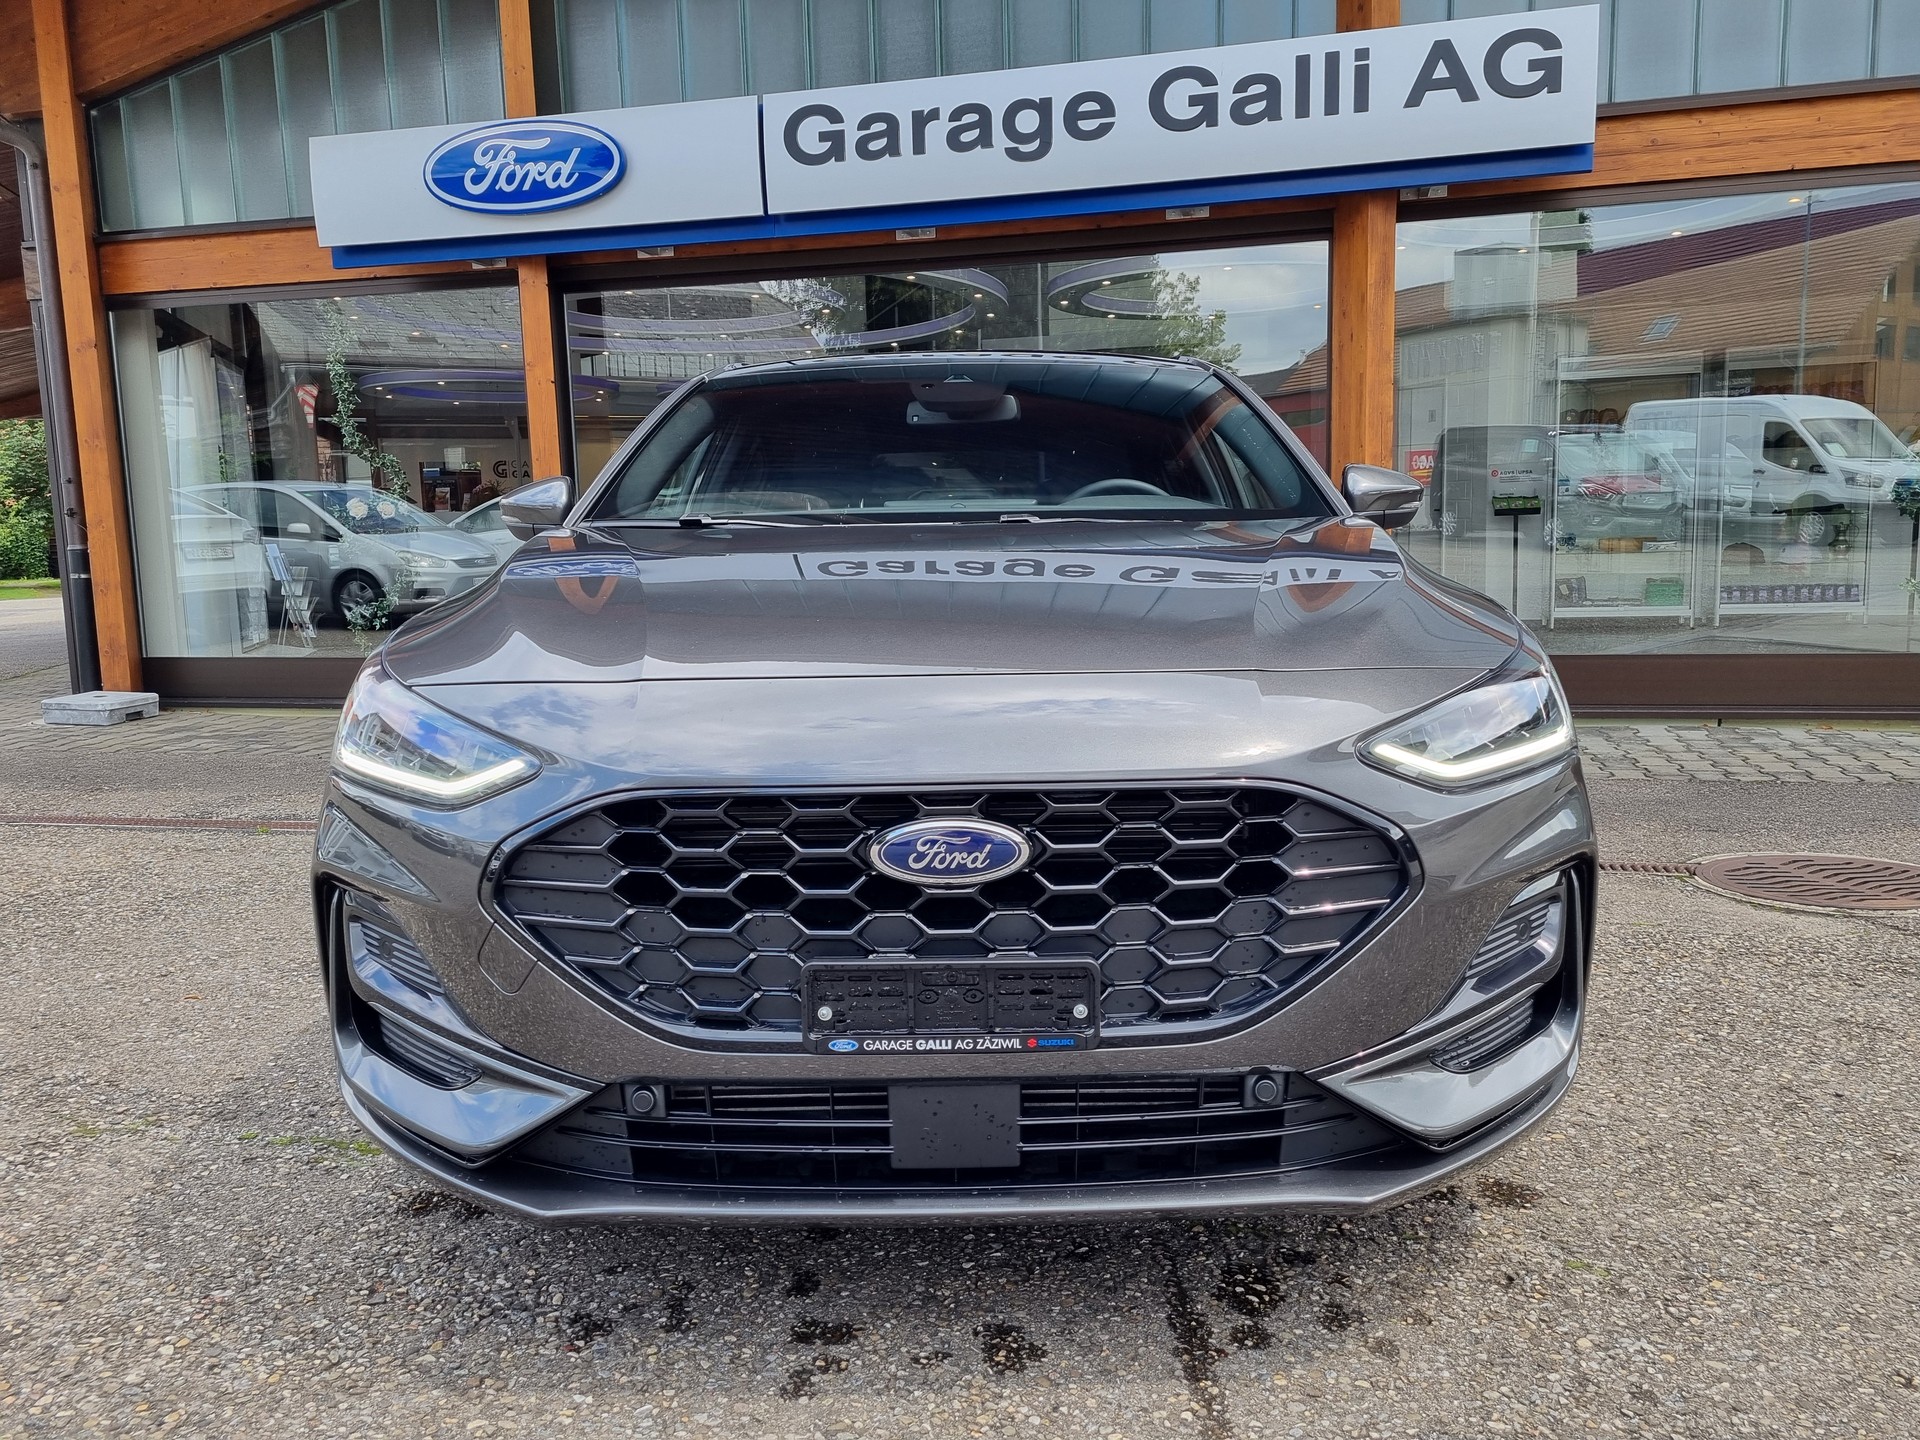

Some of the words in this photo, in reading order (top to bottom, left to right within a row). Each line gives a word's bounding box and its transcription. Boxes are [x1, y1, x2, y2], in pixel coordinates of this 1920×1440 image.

[783, 90, 1116, 166] Garage
[1148, 46, 1370, 132] Galli
[1403, 28, 1563, 108] AG
[464, 137, 581, 195] Ford
[511, 460, 530, 469] GA
[511, 470, 530, 478] GA
[908, 835, 991, 870] Ford
[863, 1039, 913, 1051] GARAGE
[915, 1039, 952, 1050] GALLI
[955, 1038, 973, 1050] AG
[976, 1036, 1022, 1050] ZÄZIWIL
[1038, 1038, 1075, 1047] SUZUKI
